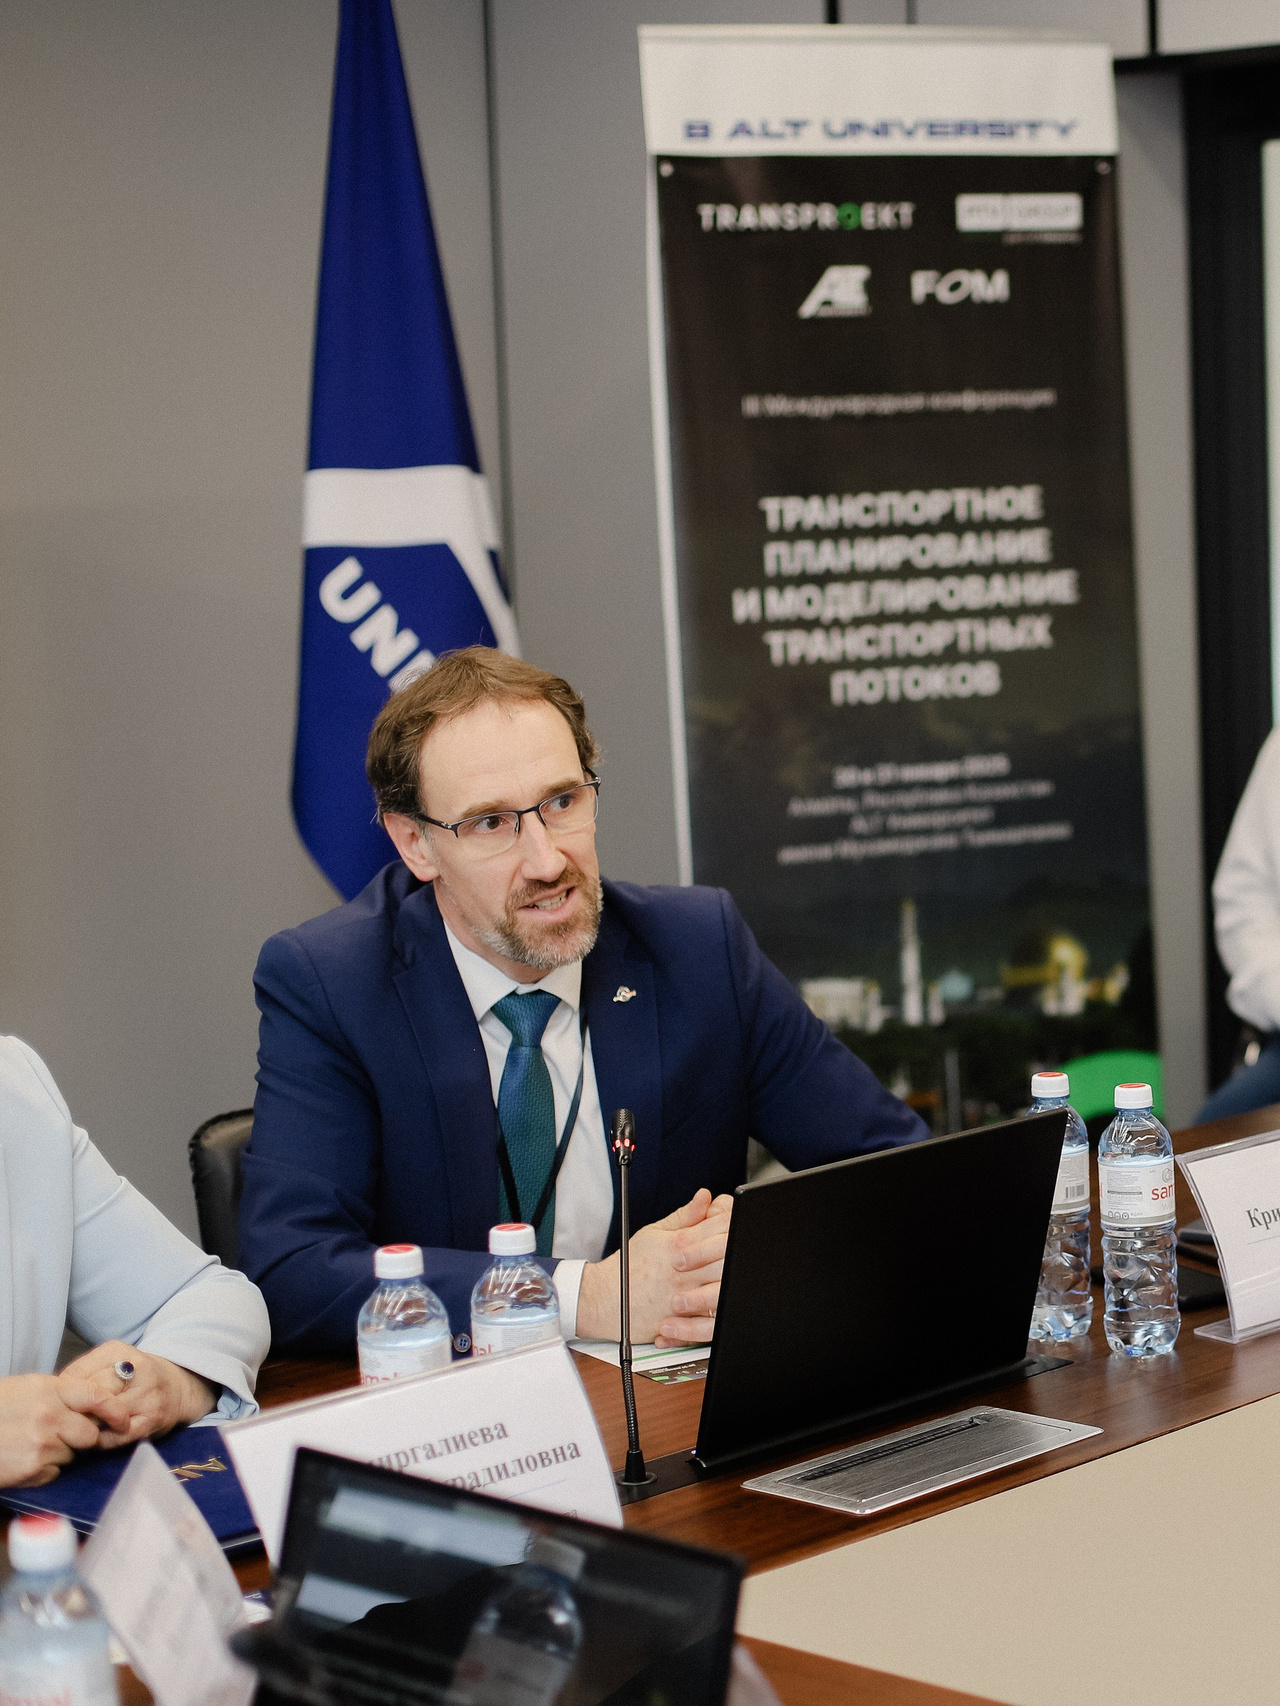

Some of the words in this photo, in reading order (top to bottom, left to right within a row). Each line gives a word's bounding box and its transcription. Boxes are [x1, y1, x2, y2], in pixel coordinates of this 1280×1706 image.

[727, 119, 809, 140] ALT
[823, 119, 1079, 140] UNIVERSITY
[697, 202, 916, 232] TRANSPROEKT
[911, 269, 1010, 305] FOM
[761, 485, 1043, 531] ТРАНСПОРТНОЕ
[764, 528, 1051, 576] ПЛАНИРОВАНИЕ
[732, 588, 759, 623] И
[764, 569, 1080, 623] МОДЕЛИРОВАНИЕ
[763, 615, 1053, 665] ТРАНСПОРТНЫХ
[831, 661, 1001, 706] ПОТОКОВ
